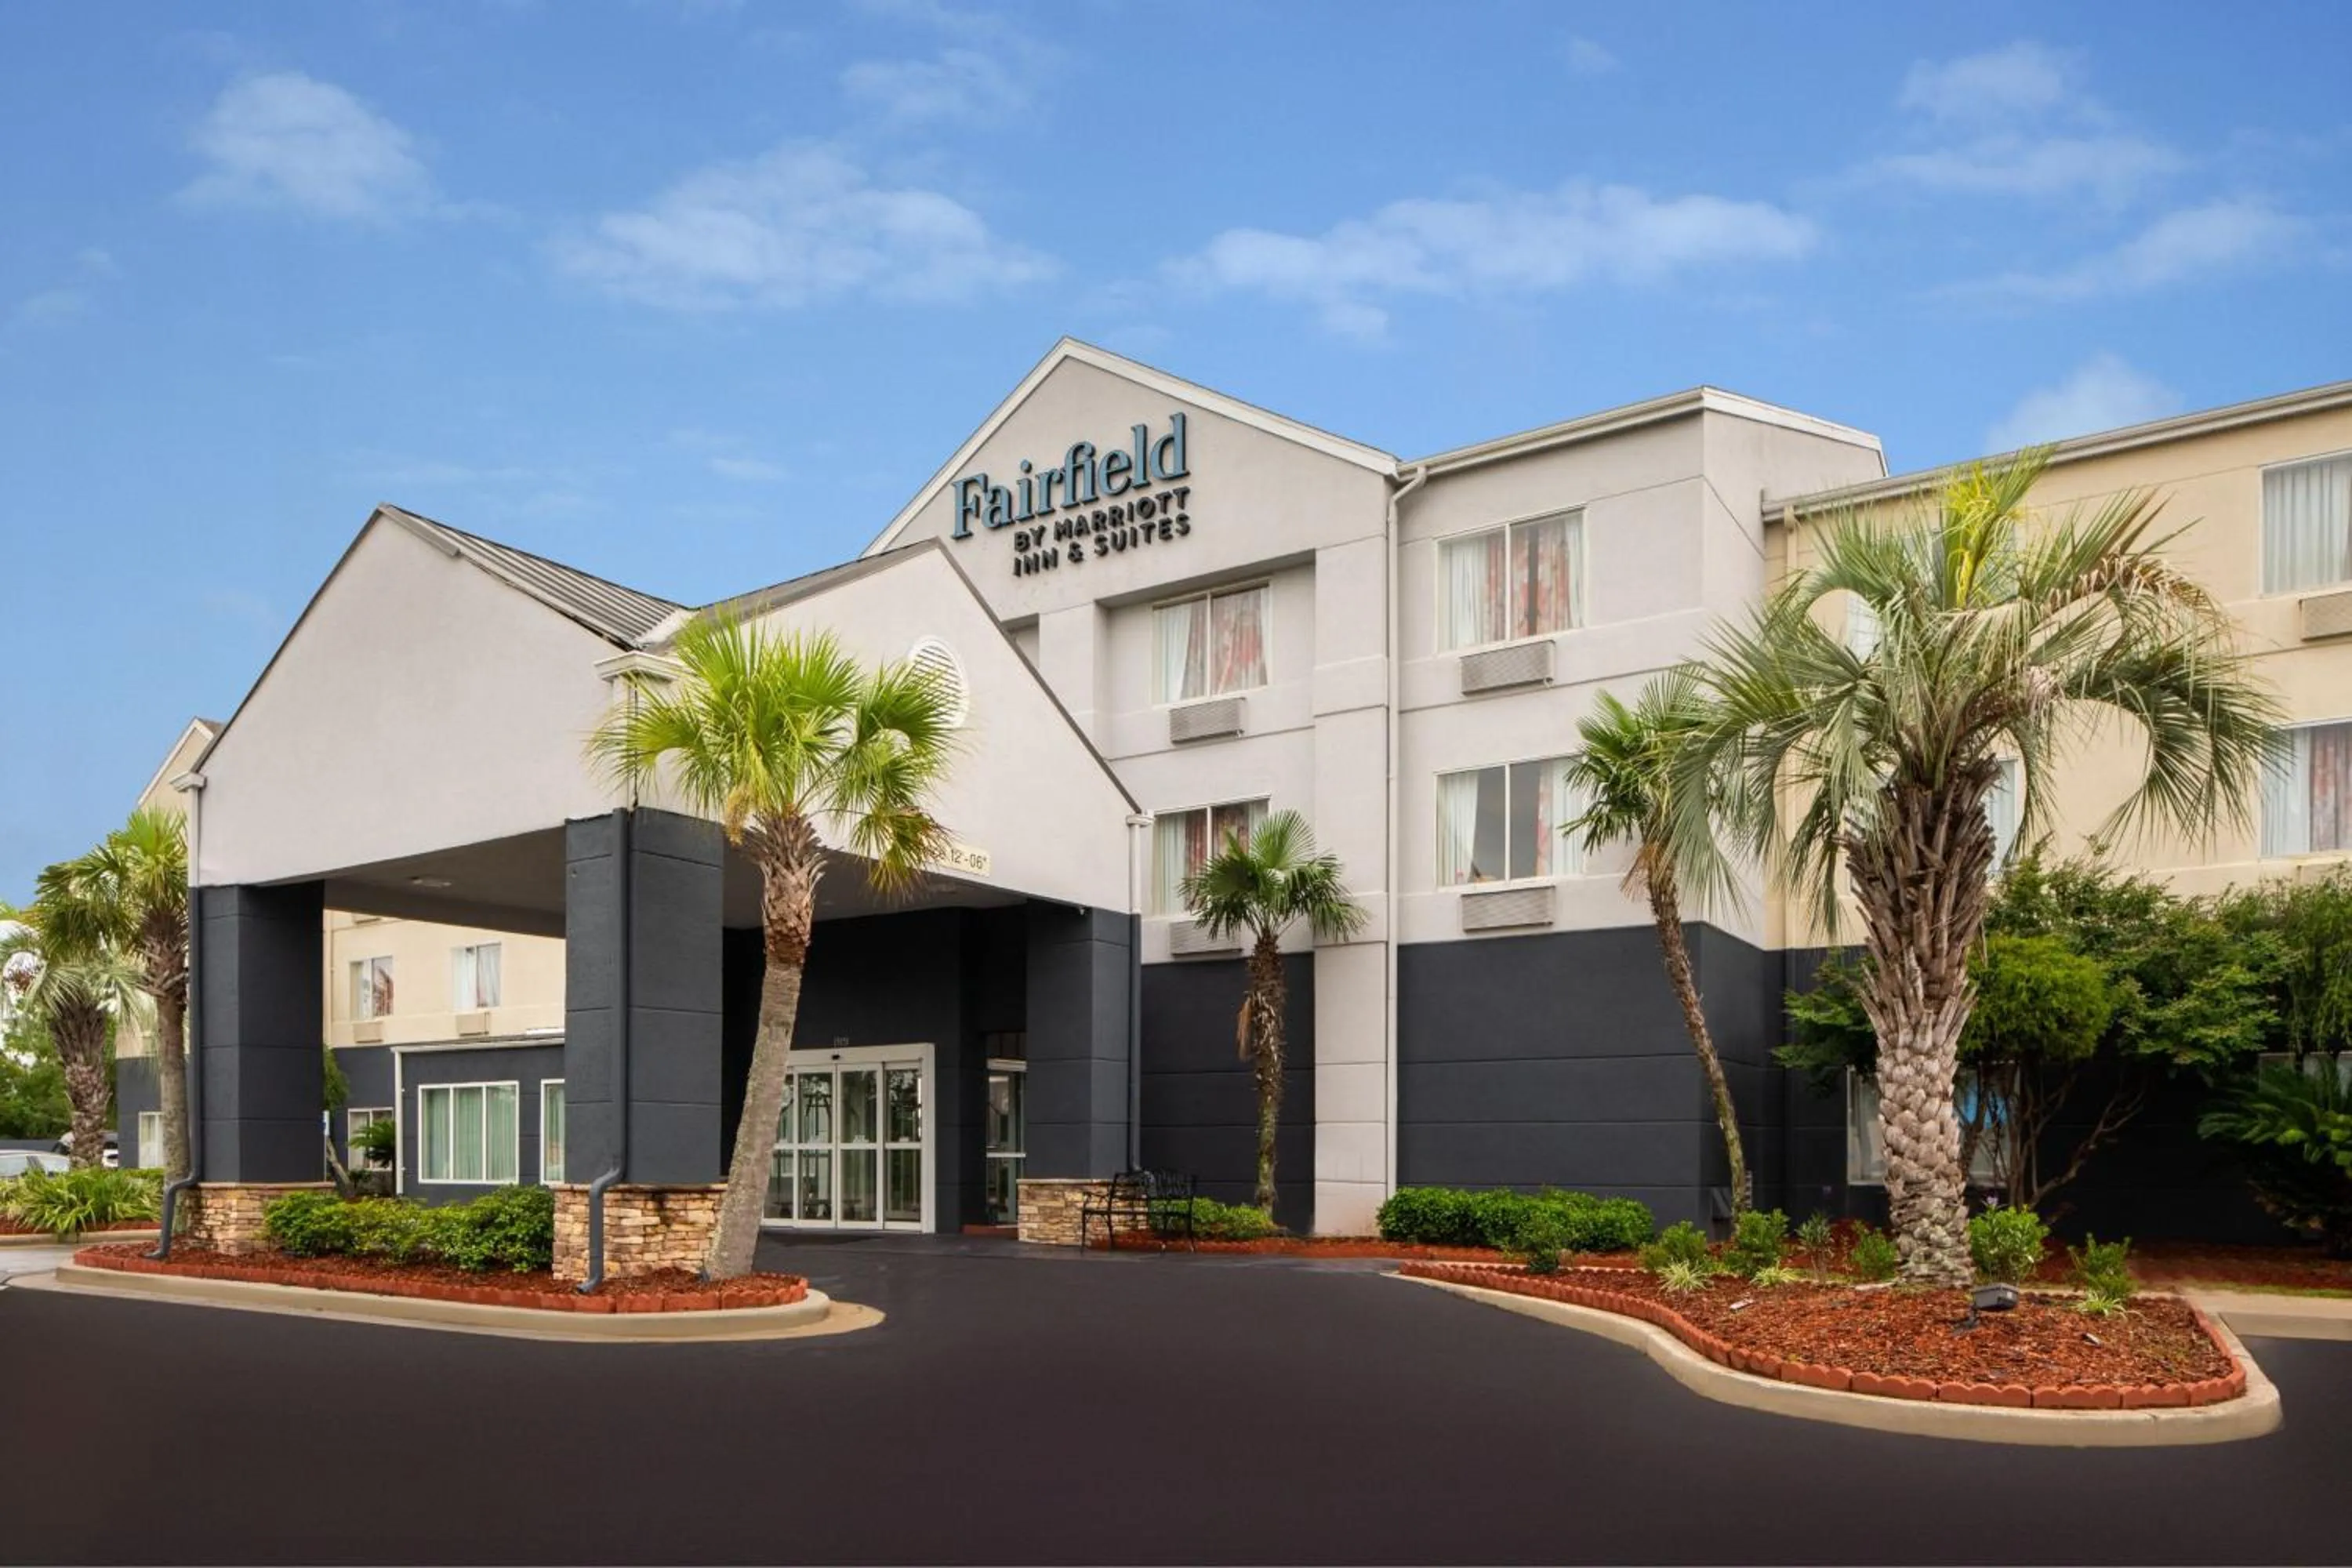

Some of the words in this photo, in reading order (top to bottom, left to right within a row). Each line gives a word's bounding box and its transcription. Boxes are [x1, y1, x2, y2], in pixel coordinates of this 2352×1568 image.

[951, 412, 1190, 539] Fairfield
[1014, 524, 1047, 552] BY
[1054, 487, 1190, 542] MARRIOTT
[1014, 547, 1058, 577] INN
[1068, 541, 1083, 563] &
[1094, 513, 1190, 557] SUITES
